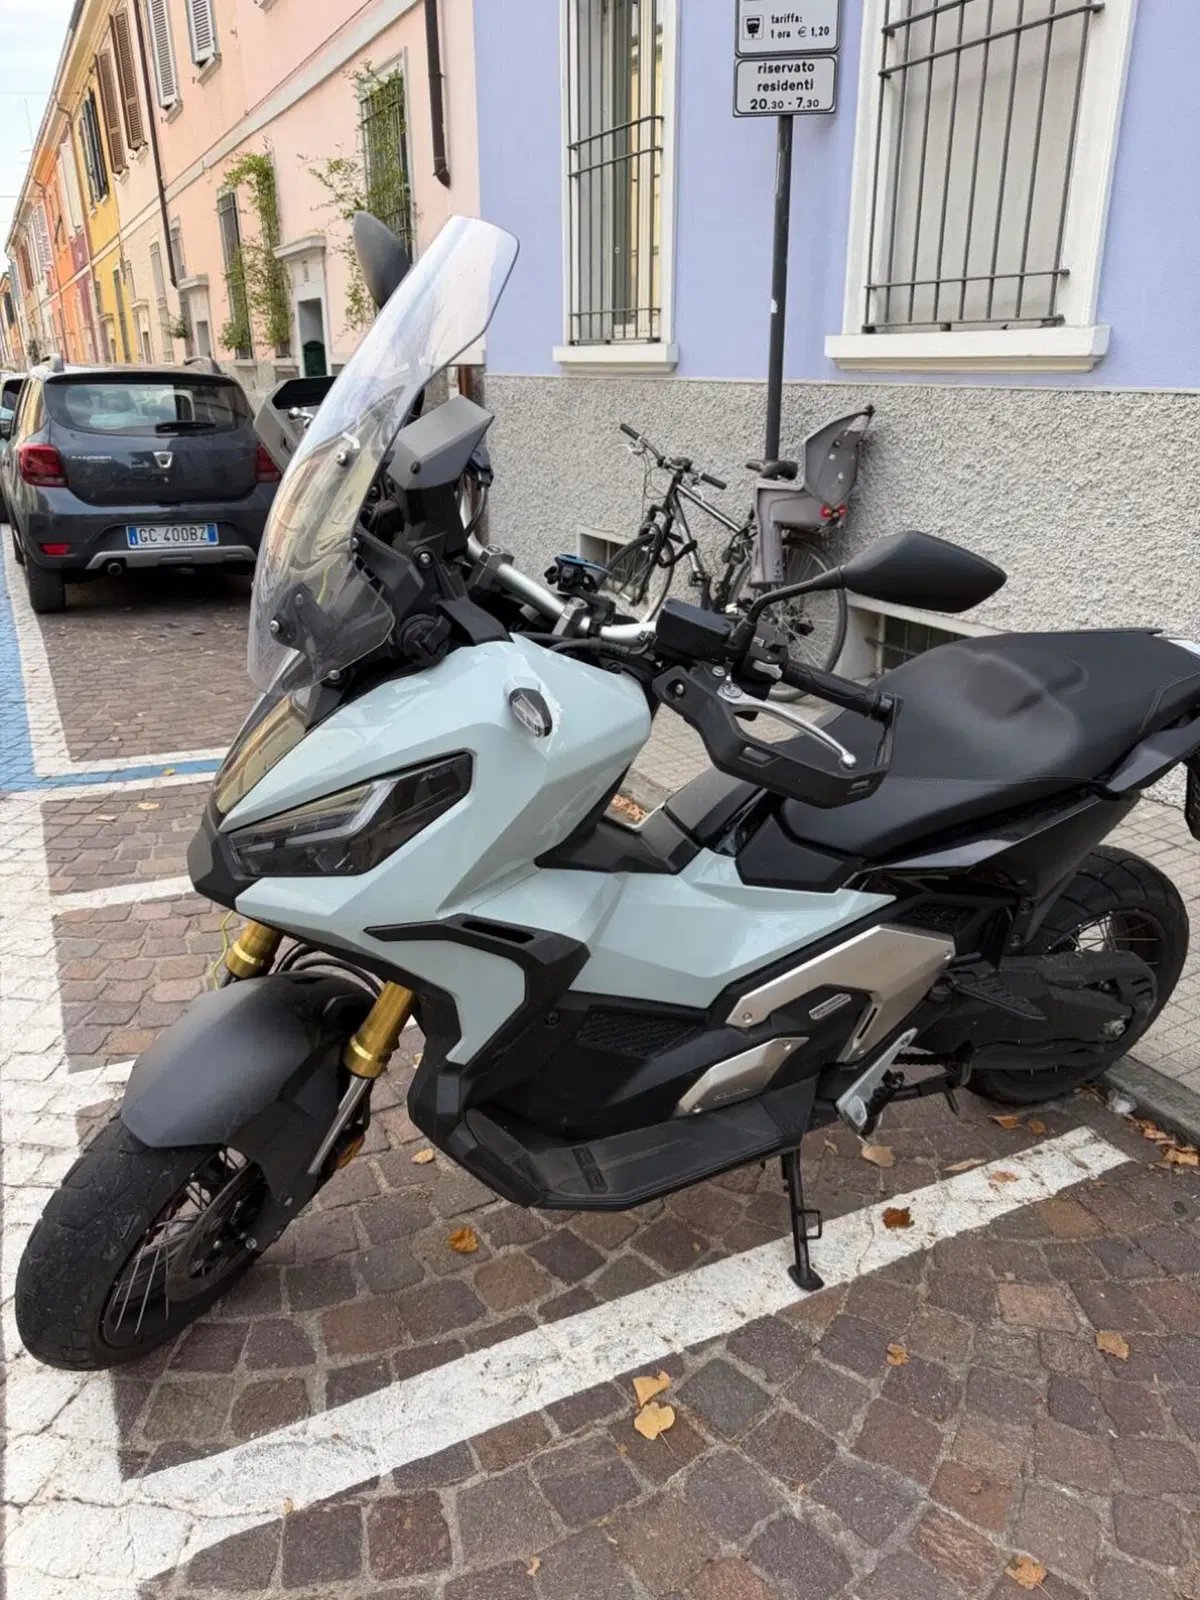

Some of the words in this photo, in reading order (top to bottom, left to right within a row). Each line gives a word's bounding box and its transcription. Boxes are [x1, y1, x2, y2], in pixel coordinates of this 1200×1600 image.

[771, 13, 803, 24] tariffa:
[771, 29, 775, 39] 1
[777, 30, 791, 38] ora
[797, 26, 808, 38] €
[757, 61, 815, 74] riservato
[757, 79, 814, 92] residenti
[750, 98, 784, 110] 20.30
[796, 97, 820, 109] 7.30
